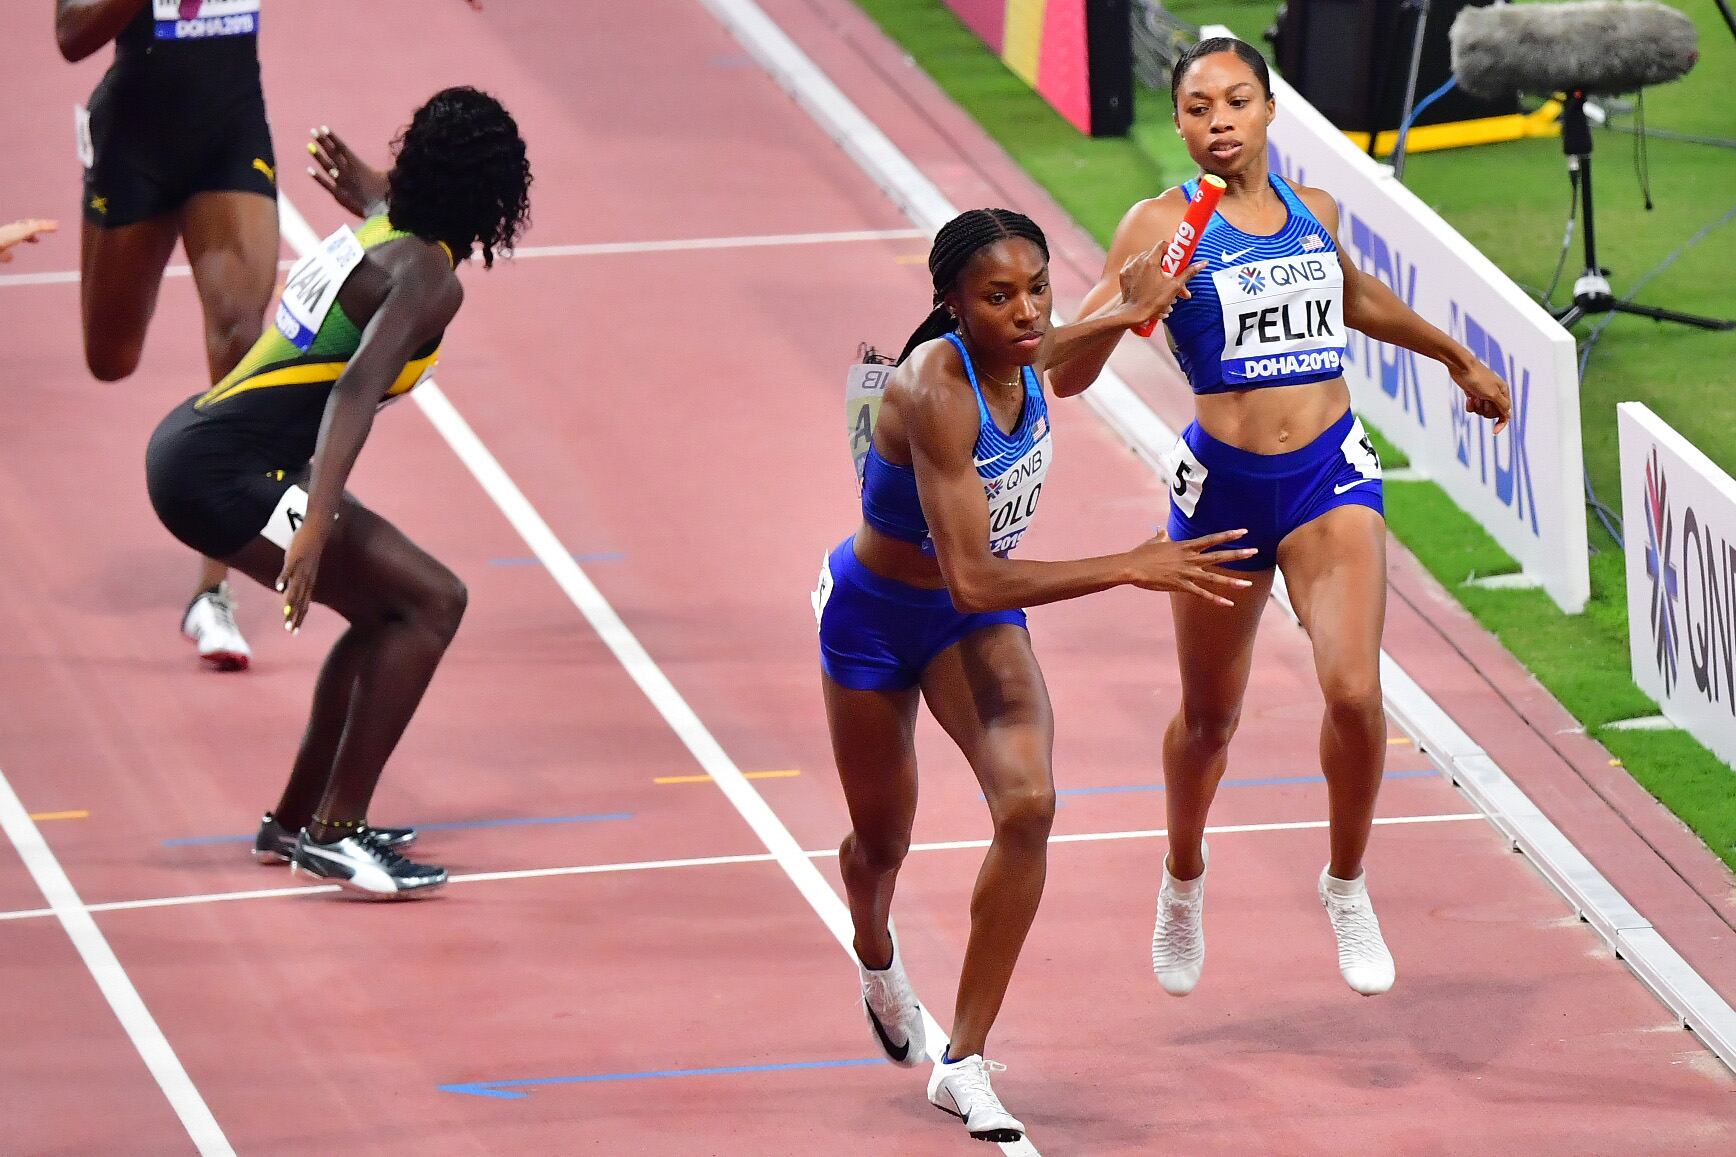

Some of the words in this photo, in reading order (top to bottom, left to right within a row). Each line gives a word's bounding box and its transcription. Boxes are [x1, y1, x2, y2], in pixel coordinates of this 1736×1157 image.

[1162, 220, 1196, 278] 2019
[1269, 260, 1327, 287] QNB
[1235, 299, 1335, 347] FELIX
[1244, 350, 1340, 379] DOHA2019
[1006, 450, 1043, 491] QNB
[1173, 460, 1193, 497] 5
[1683, 505, 1736, 717] QN
